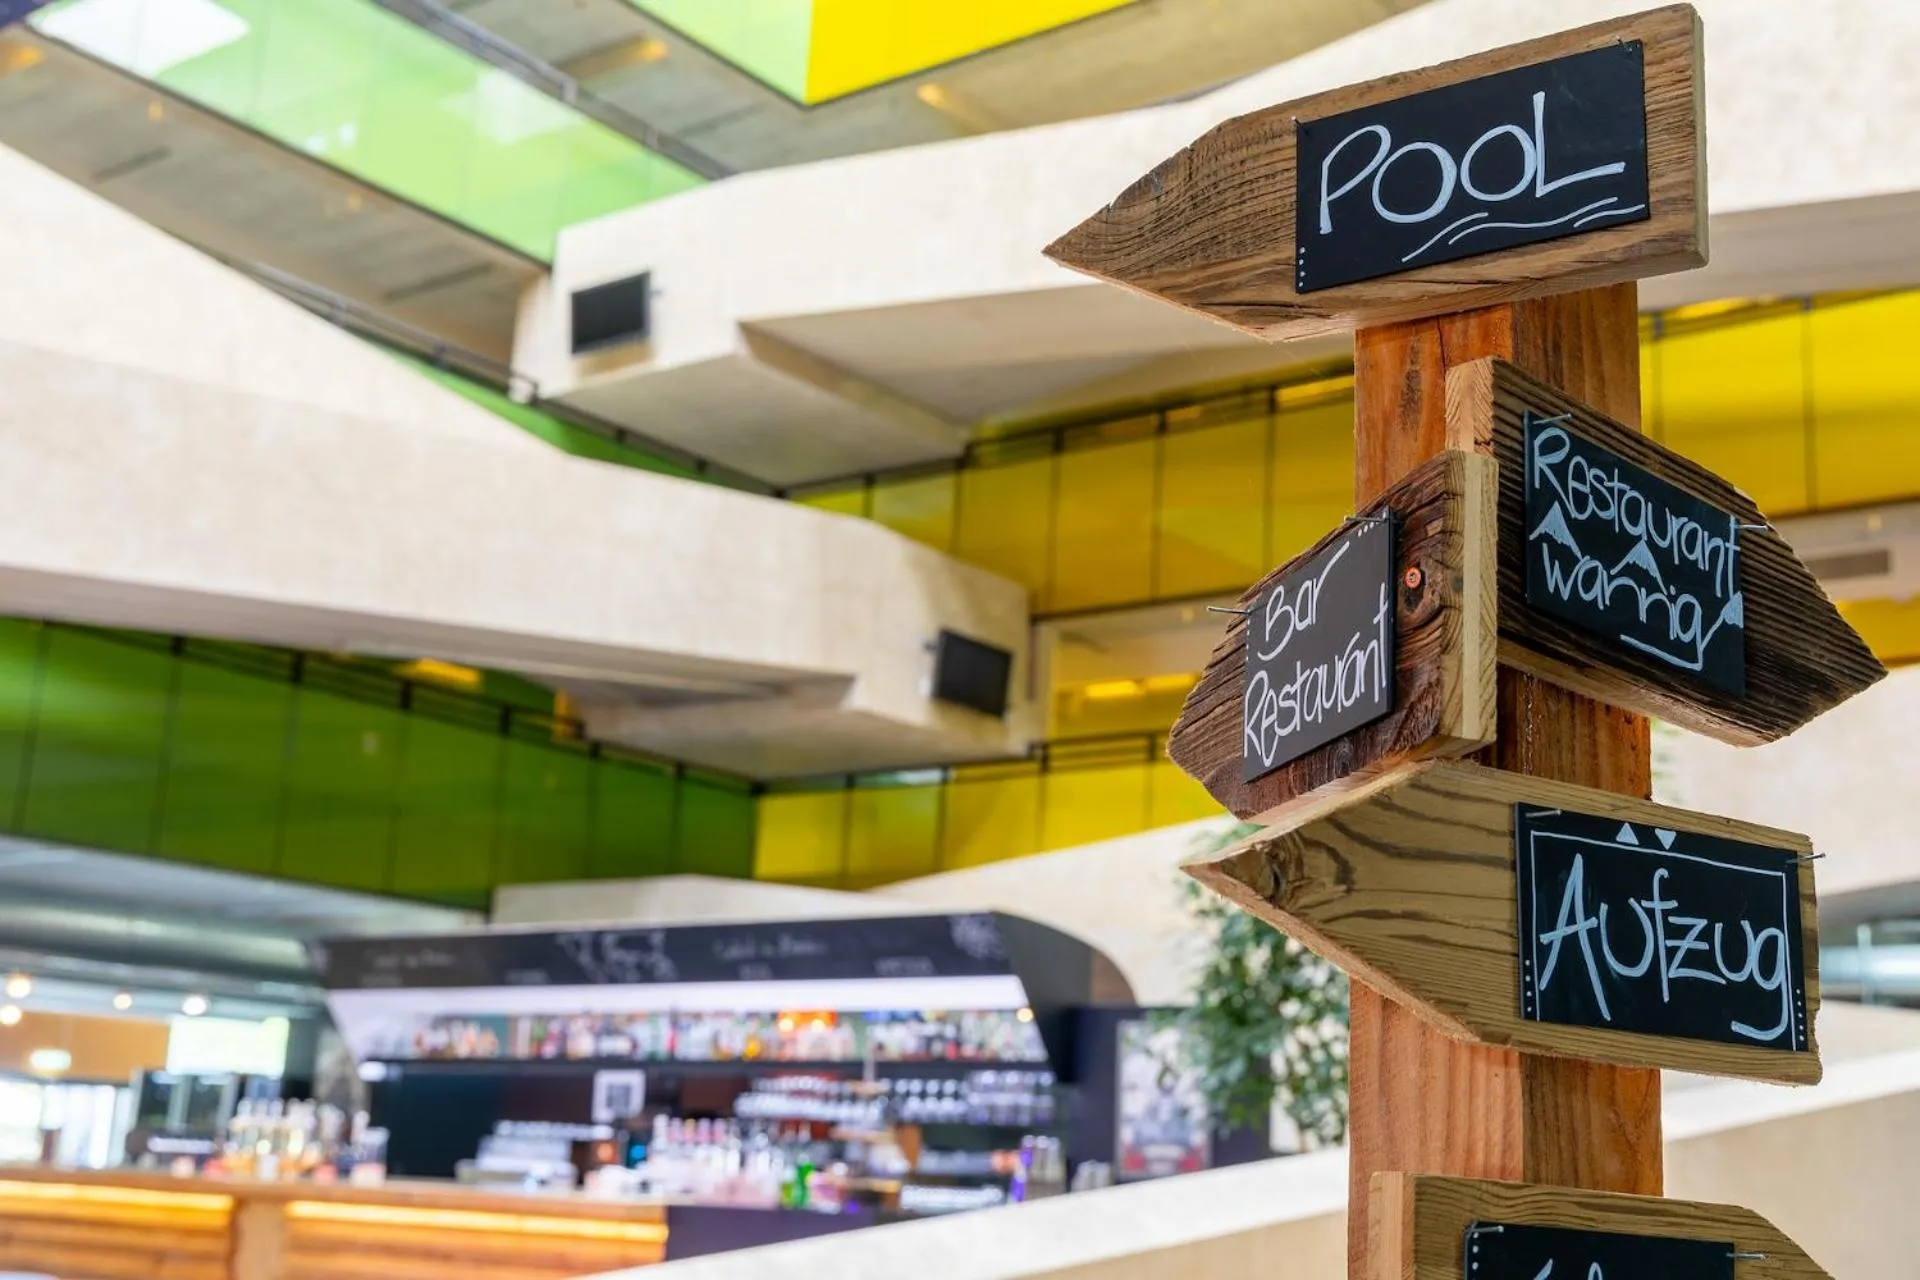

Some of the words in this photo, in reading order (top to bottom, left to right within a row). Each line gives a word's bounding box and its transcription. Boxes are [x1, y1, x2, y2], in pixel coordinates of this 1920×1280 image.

[1257, 540, 1350, 662] Bar
[1534, 426, 1741, 603] Restaurant
[1243, 582, 1389, 768] Restaurant
[1539, 853, 1787, 1042] Aufzug
